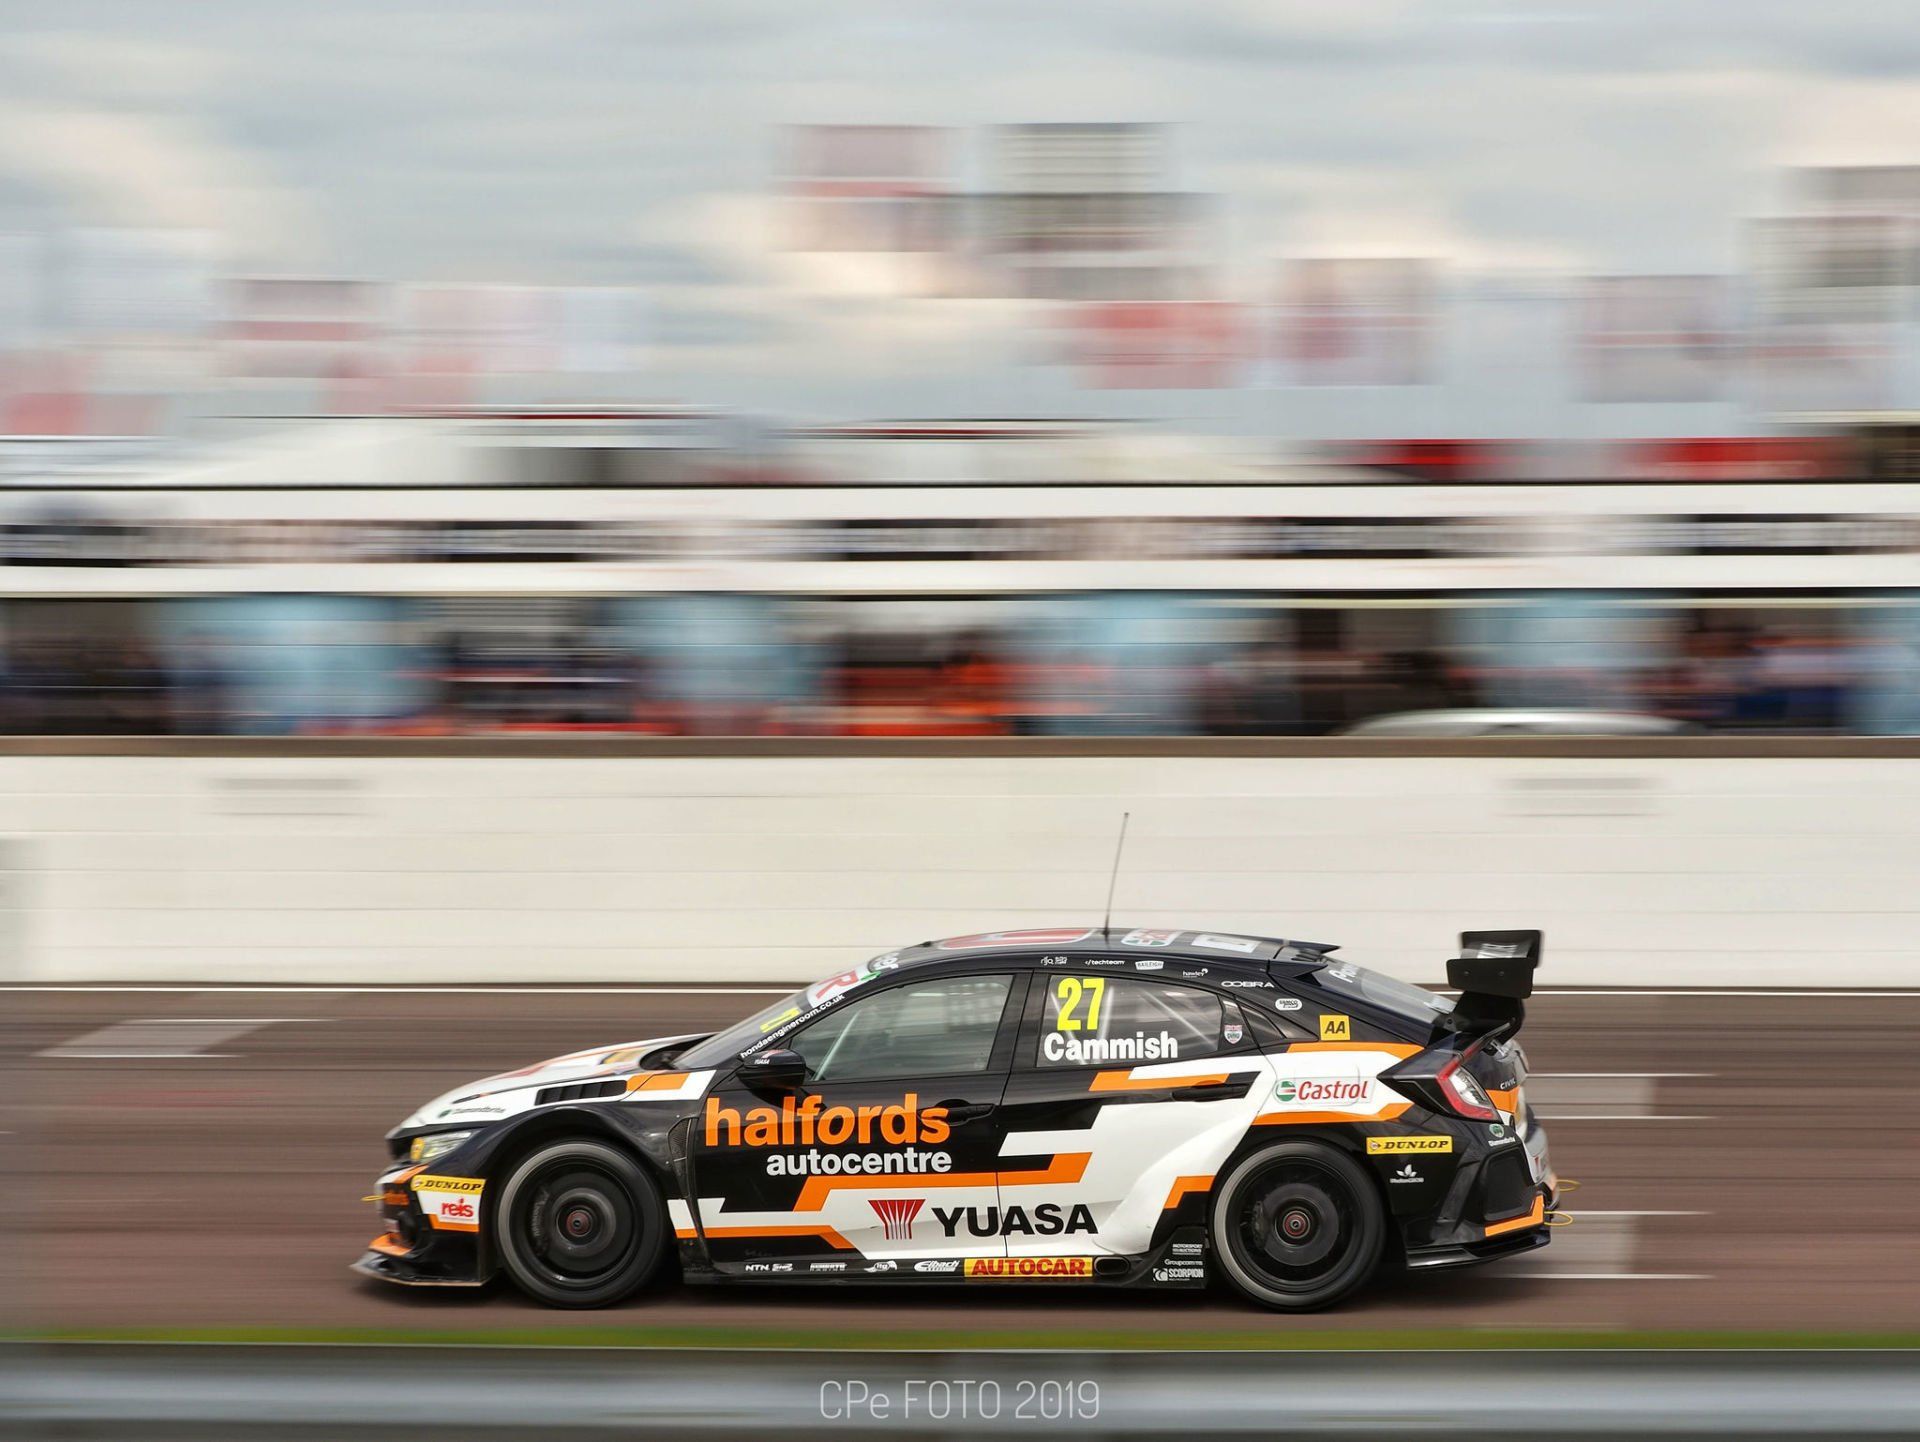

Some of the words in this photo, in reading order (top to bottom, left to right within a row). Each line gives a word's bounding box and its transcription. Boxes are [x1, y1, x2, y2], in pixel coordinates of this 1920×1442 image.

[1221, 980, 1275, 988] COBRA
[1057, 977, 1105, 1031] 27
[741, 993, 846, 1059] hondaengineroom.co.uk
[1324, 1020, 1346, 1034] AA
[1043, 1031, 1178, 1062] Cammish
[1298, 1080, 1368, 1100] Castrol
[705, 1093, 951, 1146] halfords
[1384, 1140, 1448, 1149] DUNLOP
[766, 1147, 952, 1176] autocentre
[424, 1180, 482, 1191] DUNLOP
[441, 1198, 474, 1217] reis
[931, 1203, 1099, 1237] YUASA
[971, 1258, 1085, 1276] AUTOCAR
[1168, 1268, 1204, 1278] SCORPION
